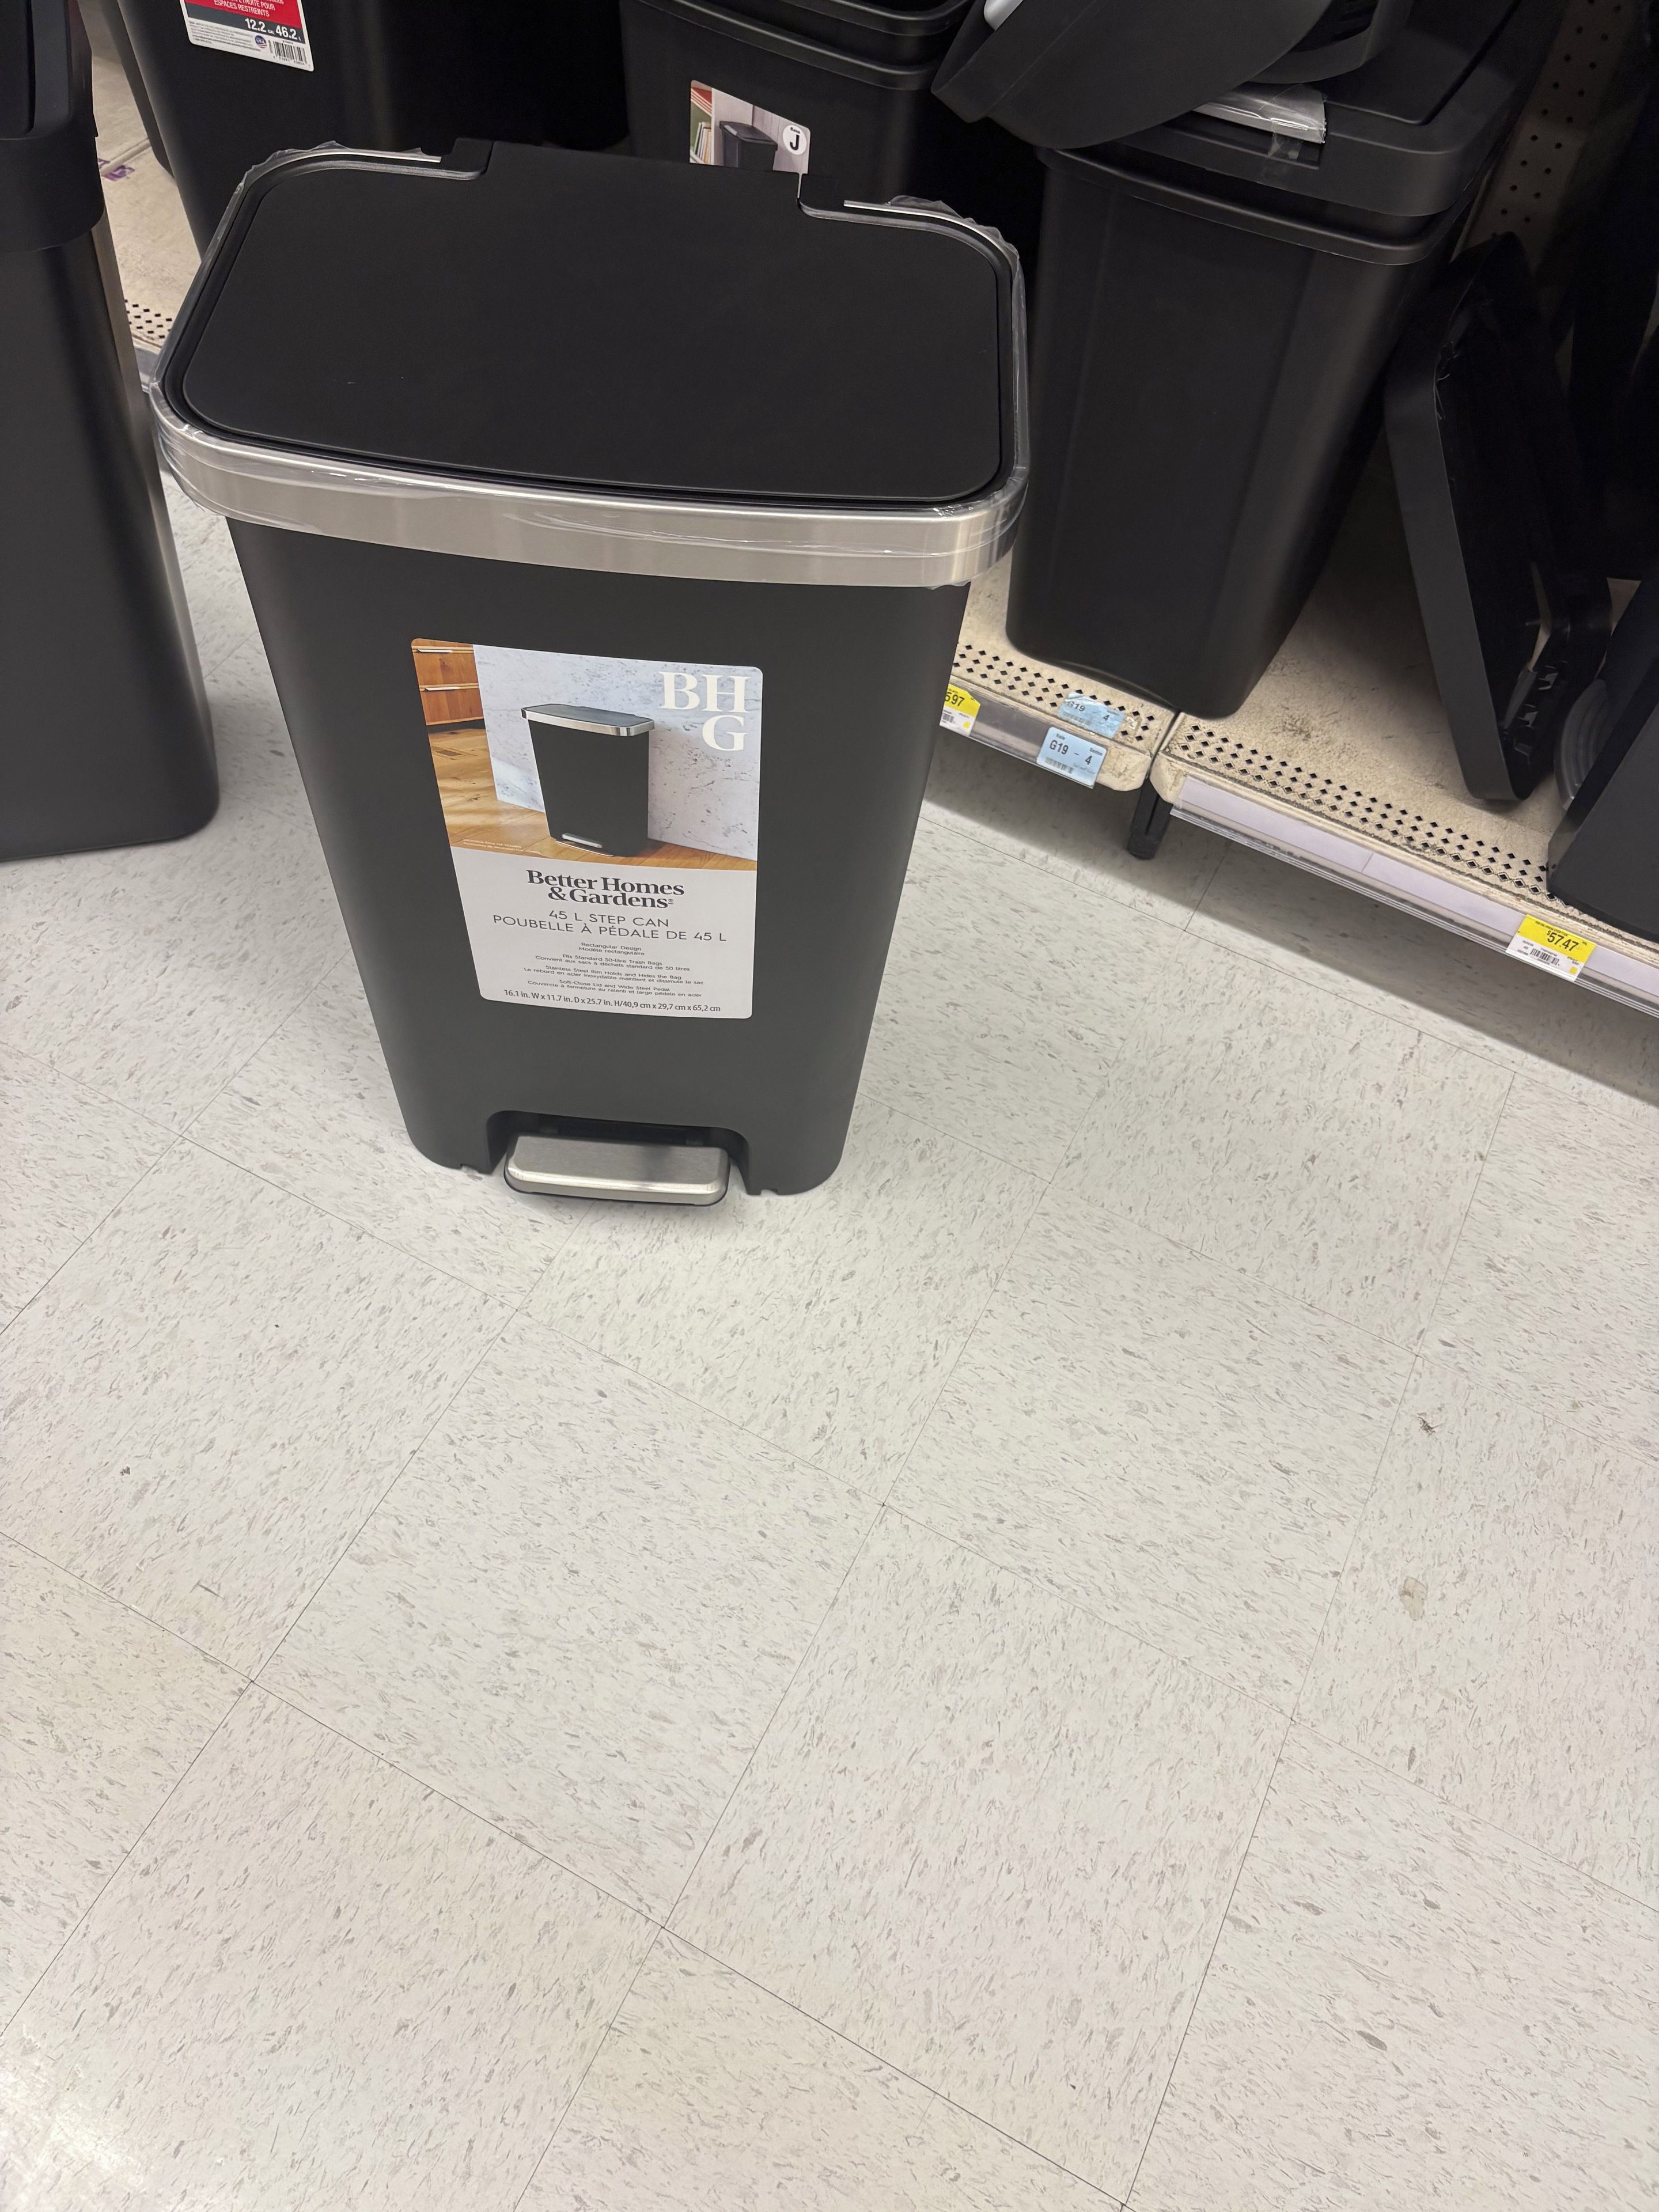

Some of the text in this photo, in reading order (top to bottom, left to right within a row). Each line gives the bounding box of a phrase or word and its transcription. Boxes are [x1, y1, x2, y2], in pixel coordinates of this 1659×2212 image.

[214, 0, 270, 17] ESPACES RESTREINTS
[261, 1, 275, 10] POUR
[245, 18, 266, 33] 12.2
[276, 25, 297, 40] 46.2
[790, 134, 800, 150] J
[1050, 740, 1069, 755] G19
[1085, 755, 1092, 765] 4
[525, 869, 684, 895] Better Homes
[493, 915, 727, 941] POUBELLE À PÉDALE DE 45 L
[548, 910, 669, 927] 45 L STEP CAN
